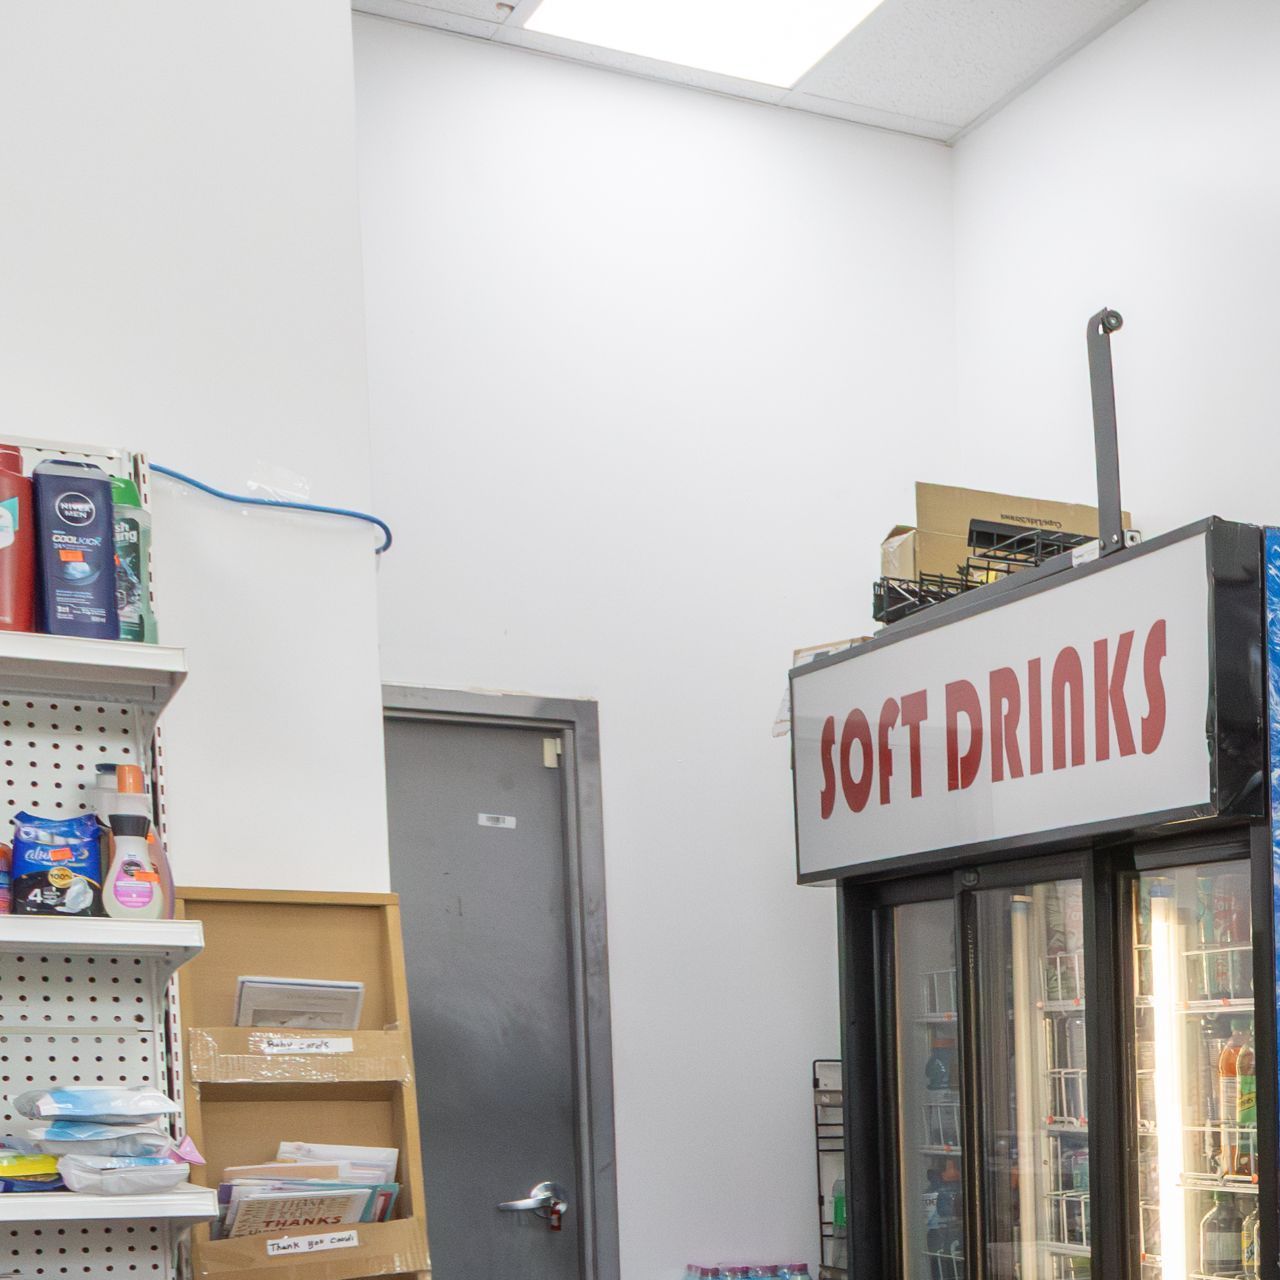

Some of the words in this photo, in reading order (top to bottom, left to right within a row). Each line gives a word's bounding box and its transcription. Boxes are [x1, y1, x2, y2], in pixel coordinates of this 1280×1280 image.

[820, 689, 928, 820] SOFT
[945, 619, 1167, 792] DRINKS
[263, 1215, 342, 1229] THANKS
[270, 1241, 300, 1252] Thank
